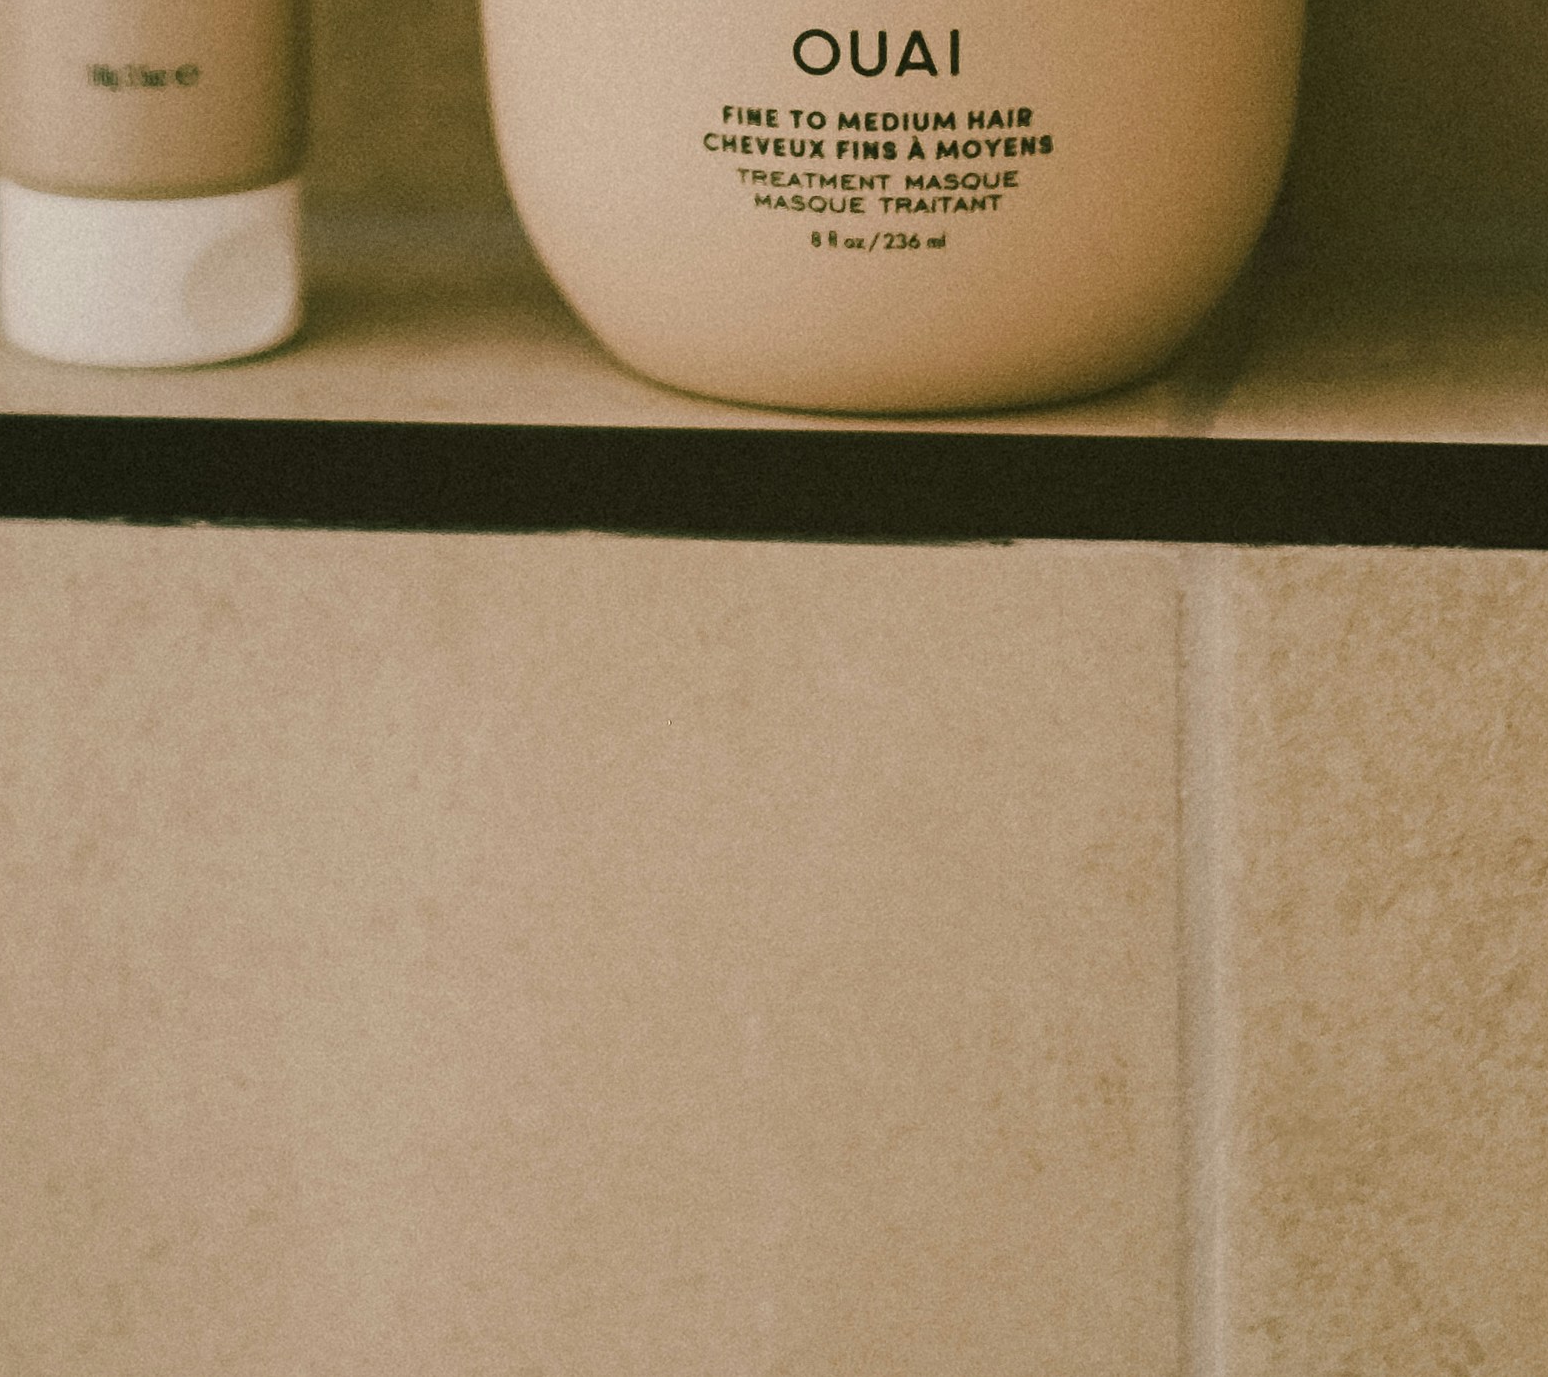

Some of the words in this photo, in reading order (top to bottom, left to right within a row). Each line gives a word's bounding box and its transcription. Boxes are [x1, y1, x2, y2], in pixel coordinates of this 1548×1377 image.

[792, 28, 960, 77] OUAI
[722, 104, 779, 129] FINE
[789, 109, 826, 130] TO
[837, 110, 956, 132] MEDIUM
[967, 107, 1034, 130] HAIR
[703, 132, 825, 160] CHEVEUX
[837, 140, 898, 161] FINS
[906, 135, 927, 161] À
[936, 134, 1055, 160] MOYENS
[738, 167, 891, 191] TREATMENT
[905, 170, 1020, 191] MASQUE
[754, 193, 866, 215] MASQUE
[879, 193, 1003, 214] TRAITANT
